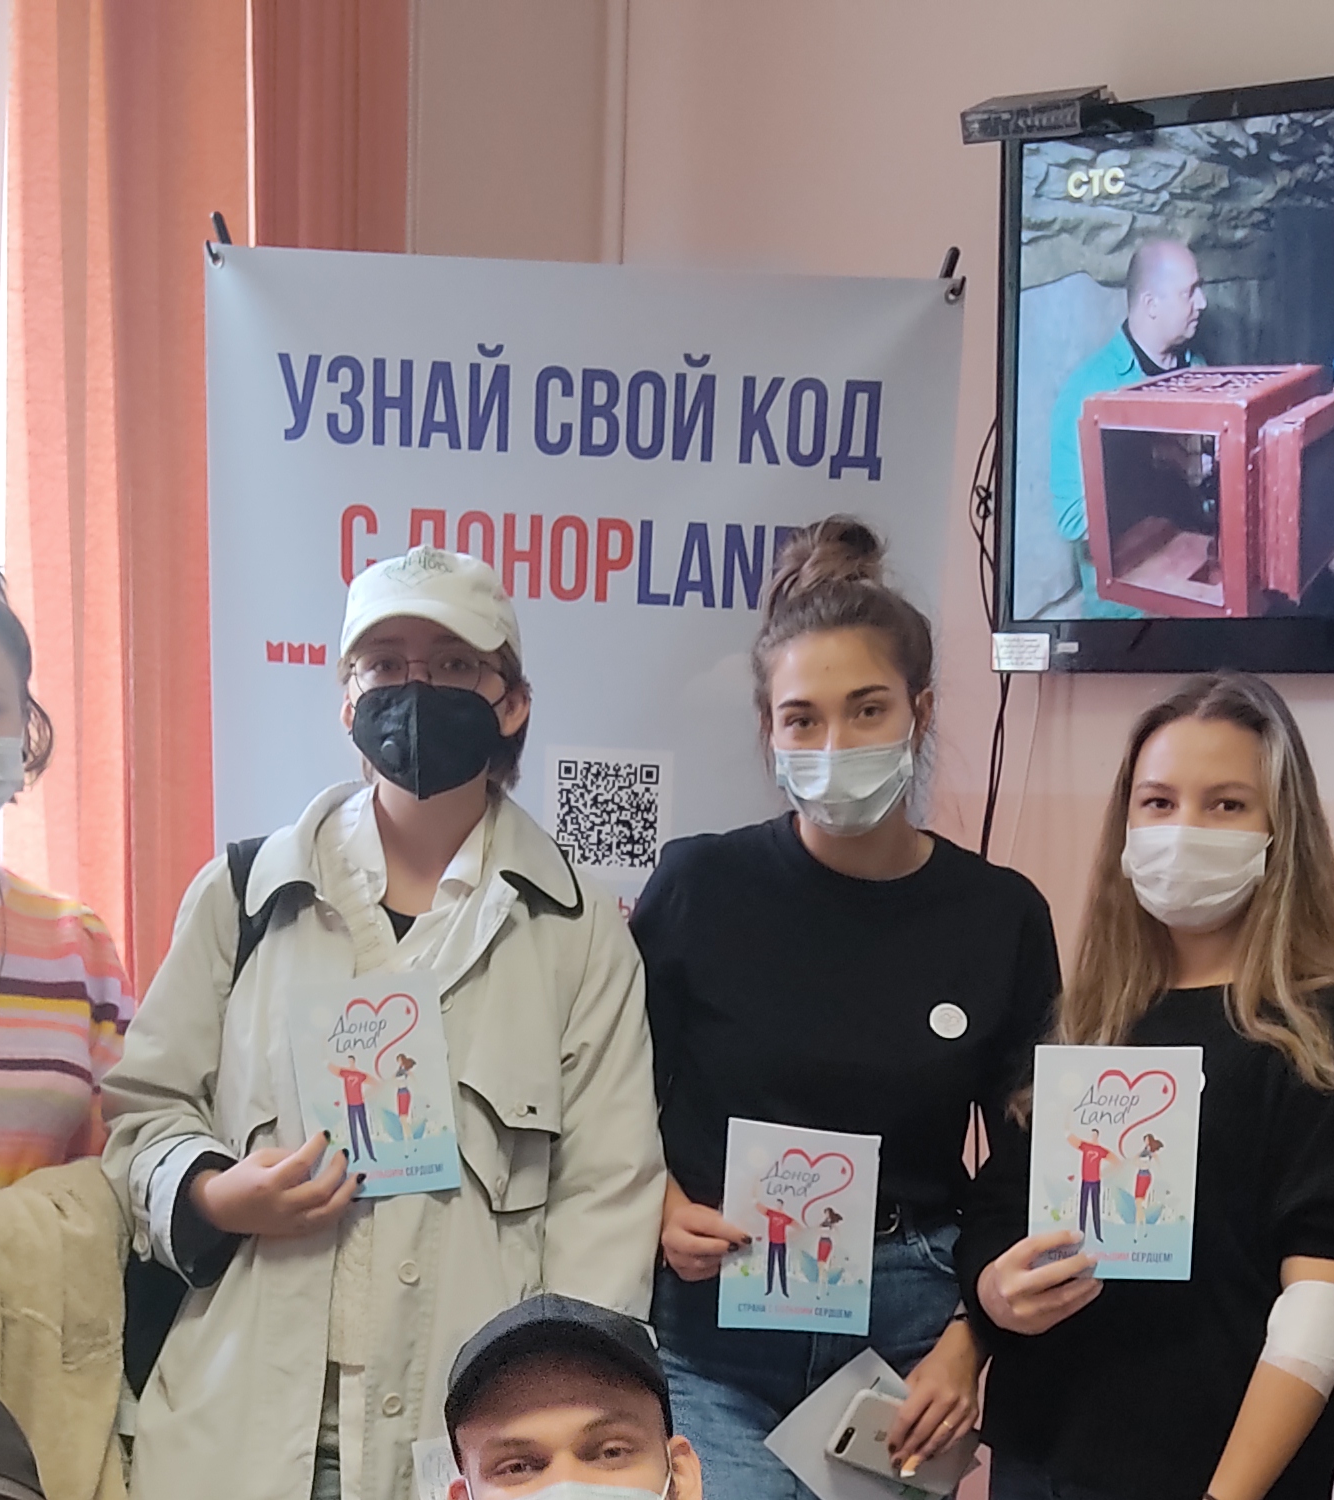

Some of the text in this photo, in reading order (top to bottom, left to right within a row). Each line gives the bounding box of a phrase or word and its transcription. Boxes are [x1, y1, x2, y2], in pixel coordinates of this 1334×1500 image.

[1068, 167, 1125, 198] СТС
[278, 343, 883, 481] УЗНАЙ СВОЙ КОД
[340, 504, 379, 588] С
[328, 1015, 387, 1042] Донор
[1073, 1084, 1140, 1113] Донор
[760, 1161, 821, 1188] Донор
